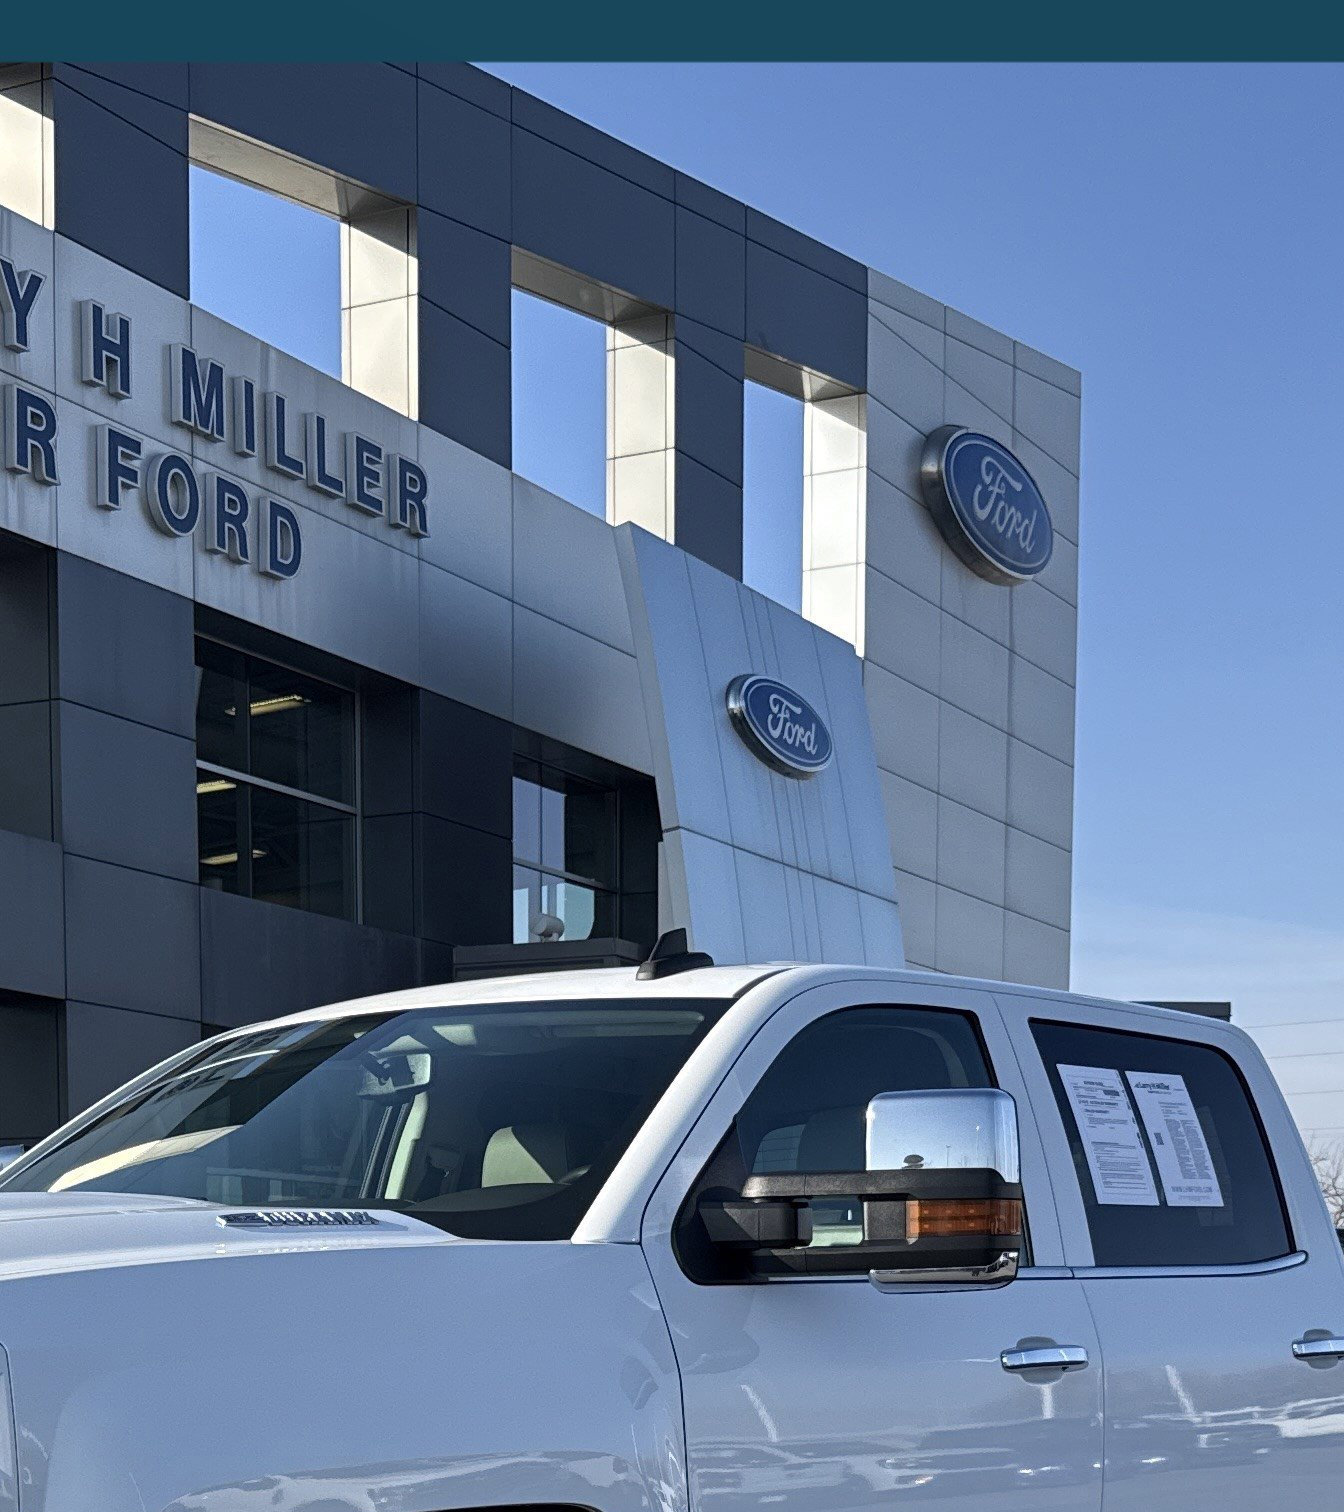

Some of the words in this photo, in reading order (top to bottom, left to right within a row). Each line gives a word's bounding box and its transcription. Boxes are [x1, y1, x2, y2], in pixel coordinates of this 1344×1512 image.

[80, 298, 133, 400] H
[169, 342, 432, 539] MILLER
[96, 423, 303, 581] FORD
[972, 455, 1037, 554] Ford
[766, 693, 818, 755] Ford
